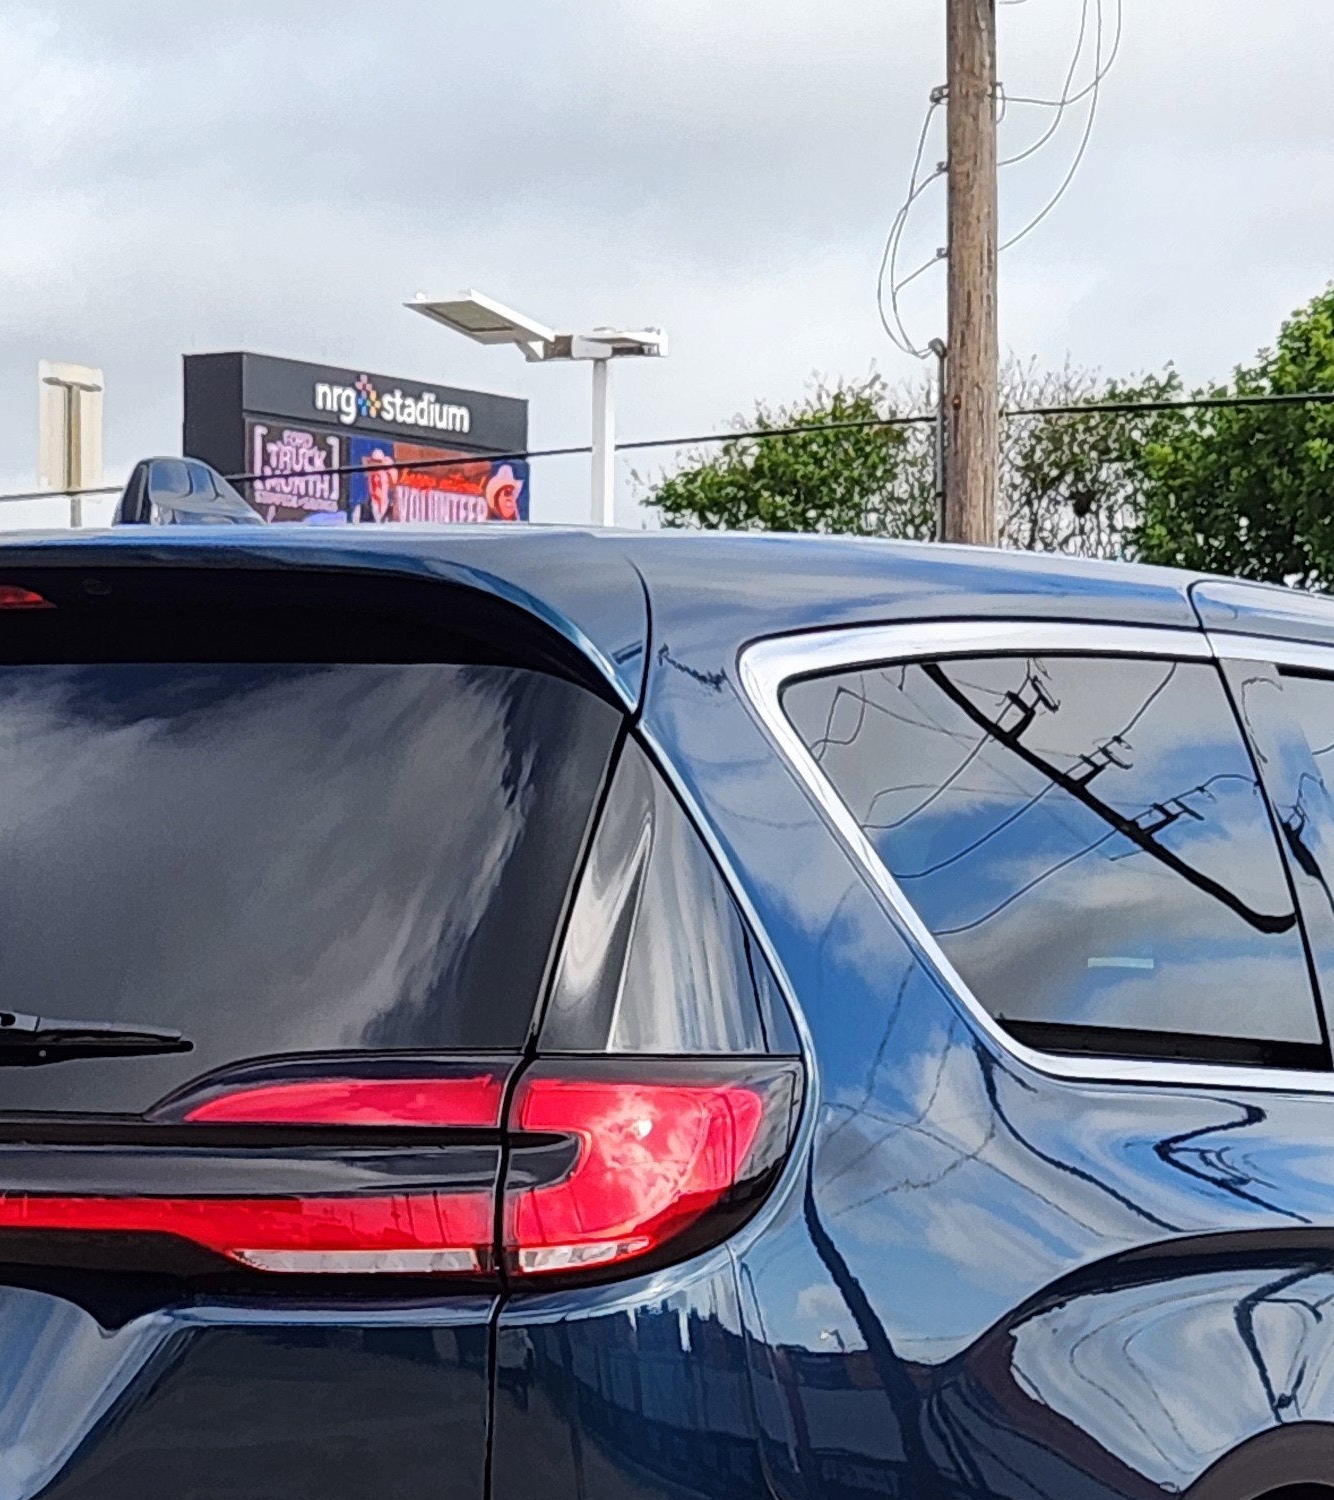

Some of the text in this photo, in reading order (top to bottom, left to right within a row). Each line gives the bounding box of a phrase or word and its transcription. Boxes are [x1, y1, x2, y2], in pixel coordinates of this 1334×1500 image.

[315, 383, 471, 433] nrg stadium
[266, 441, 327, 473] TRUCK
[265, 474, 330, 499] MONTH
